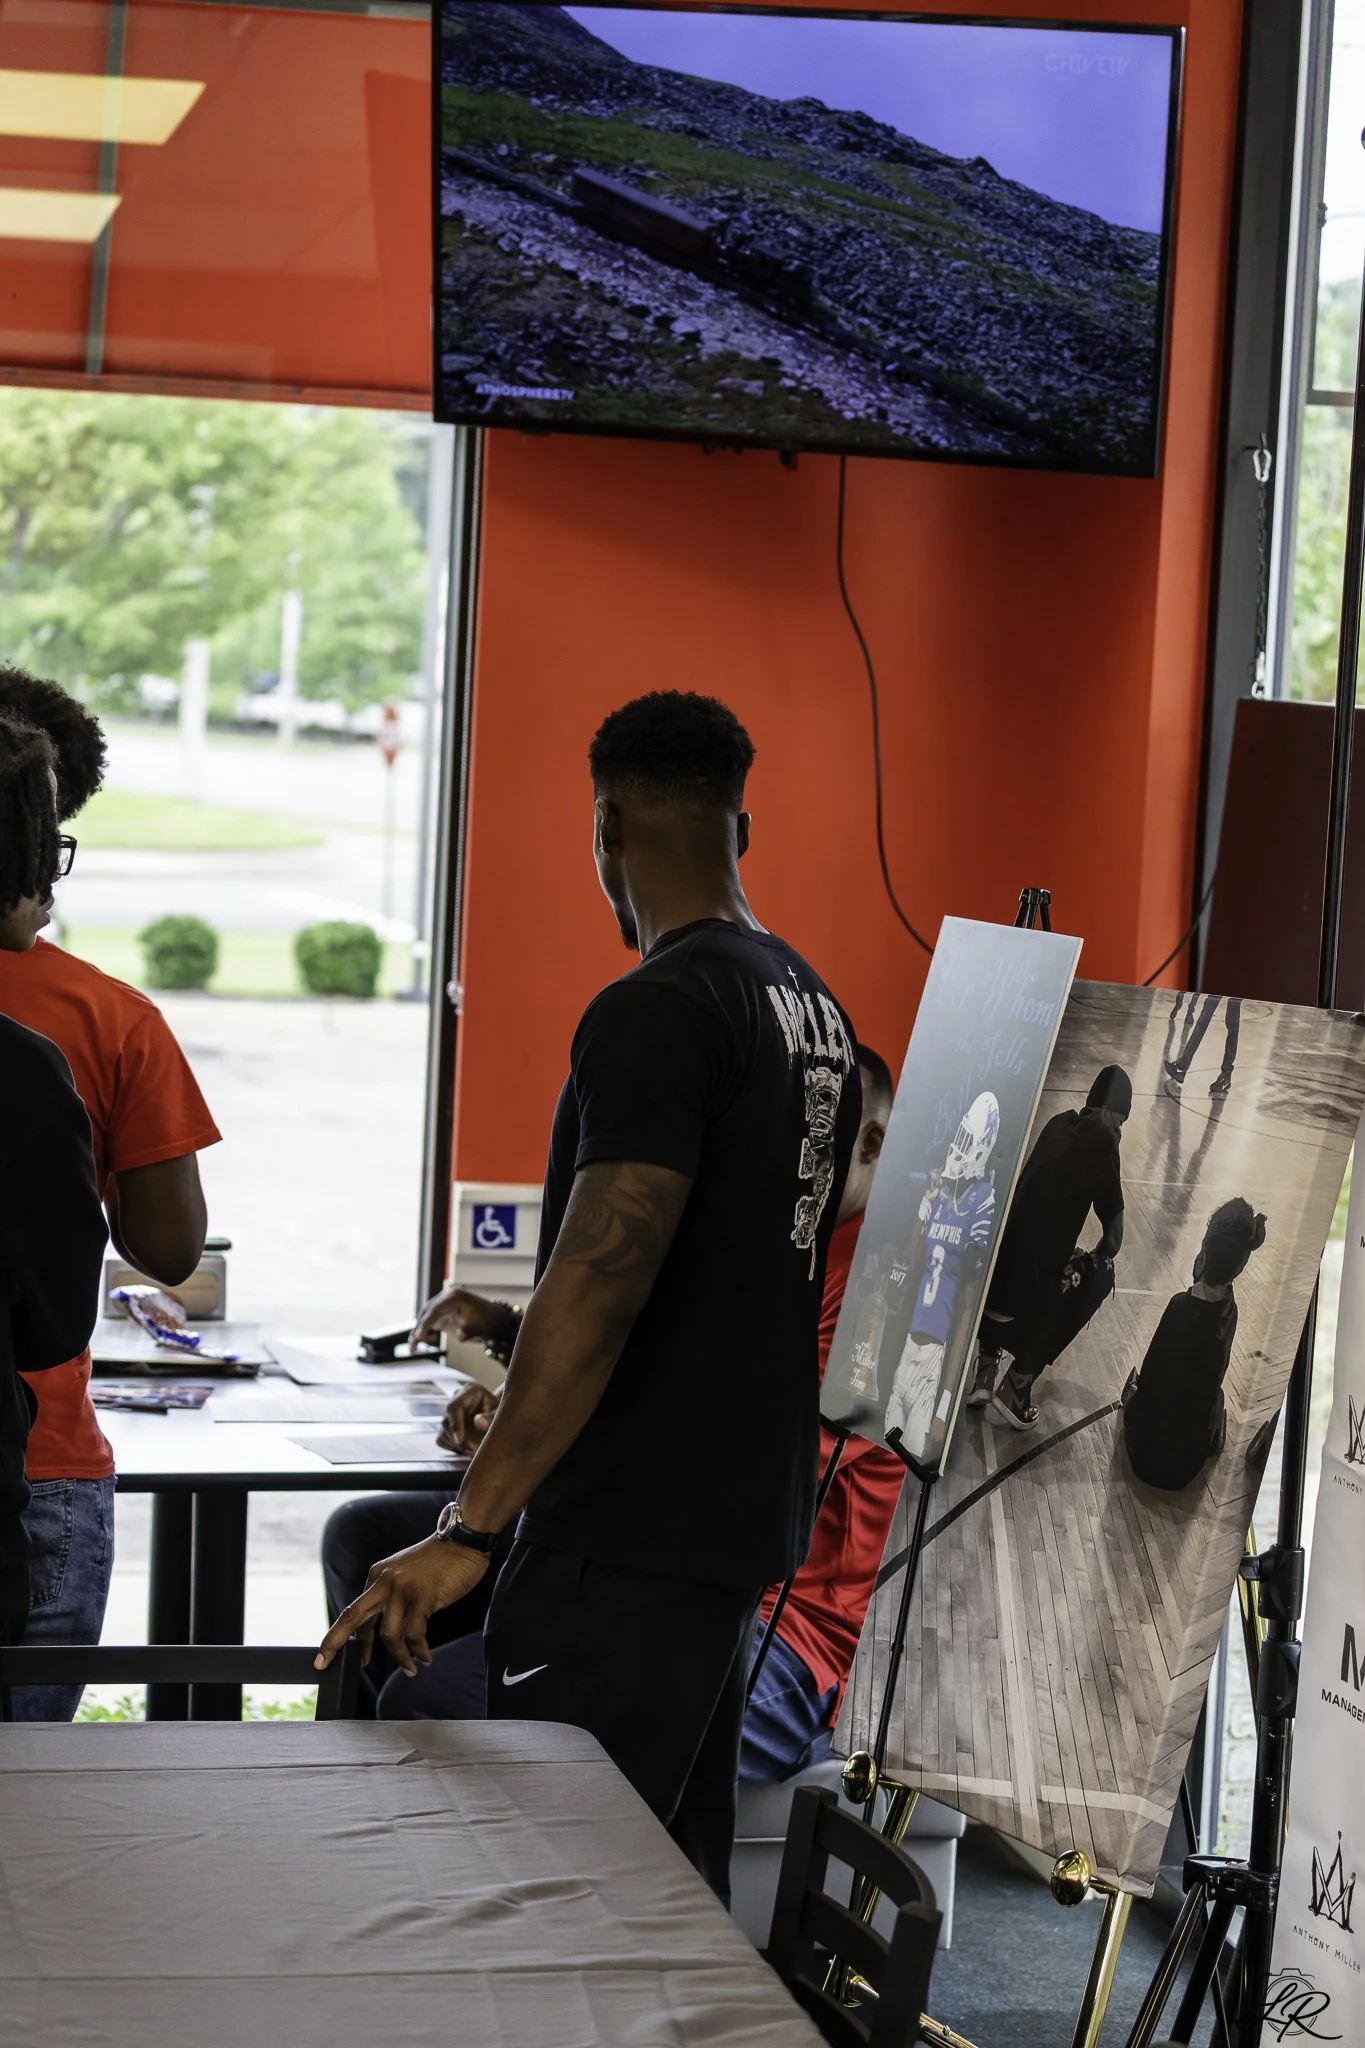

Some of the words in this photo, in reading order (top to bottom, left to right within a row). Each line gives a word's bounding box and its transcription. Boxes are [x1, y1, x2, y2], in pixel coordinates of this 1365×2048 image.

[928, 1222, 963, 1246] MEMPHIS
[1291, 1924, 1331, 1954] ANTHONY
[1334, 1949, 1361, 1976] MILLER
